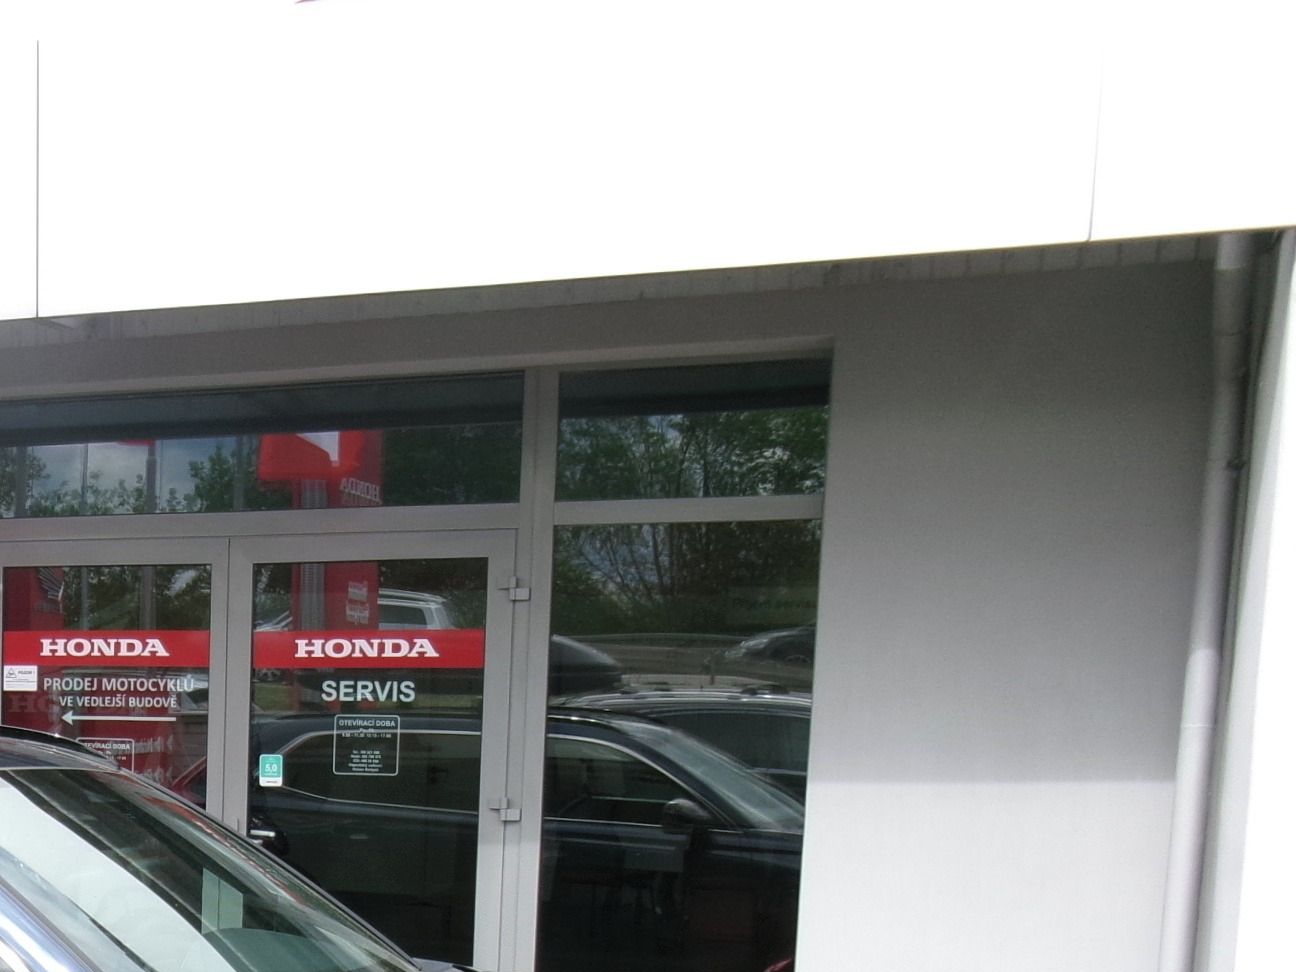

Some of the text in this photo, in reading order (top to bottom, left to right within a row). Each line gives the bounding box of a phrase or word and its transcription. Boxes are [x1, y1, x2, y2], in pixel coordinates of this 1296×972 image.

[39, 638, 170, 657] HONDA
[294, 638, 440, 658] HONDA
[43, 677, 98, 692] PRODEJ
[101, 674, 195, 692] MOTOCYKLŮ
[321, 680, 416, 703] SERVIS
[59, 696, 74, 707] VE
[76, 694, 126, 708] VEDLEJŠÍ
[128, 695, 177, 708] BUDOVĚ
[375, 719, 396, 727] DOBA
[112, 742, 131, 750] DOBA
